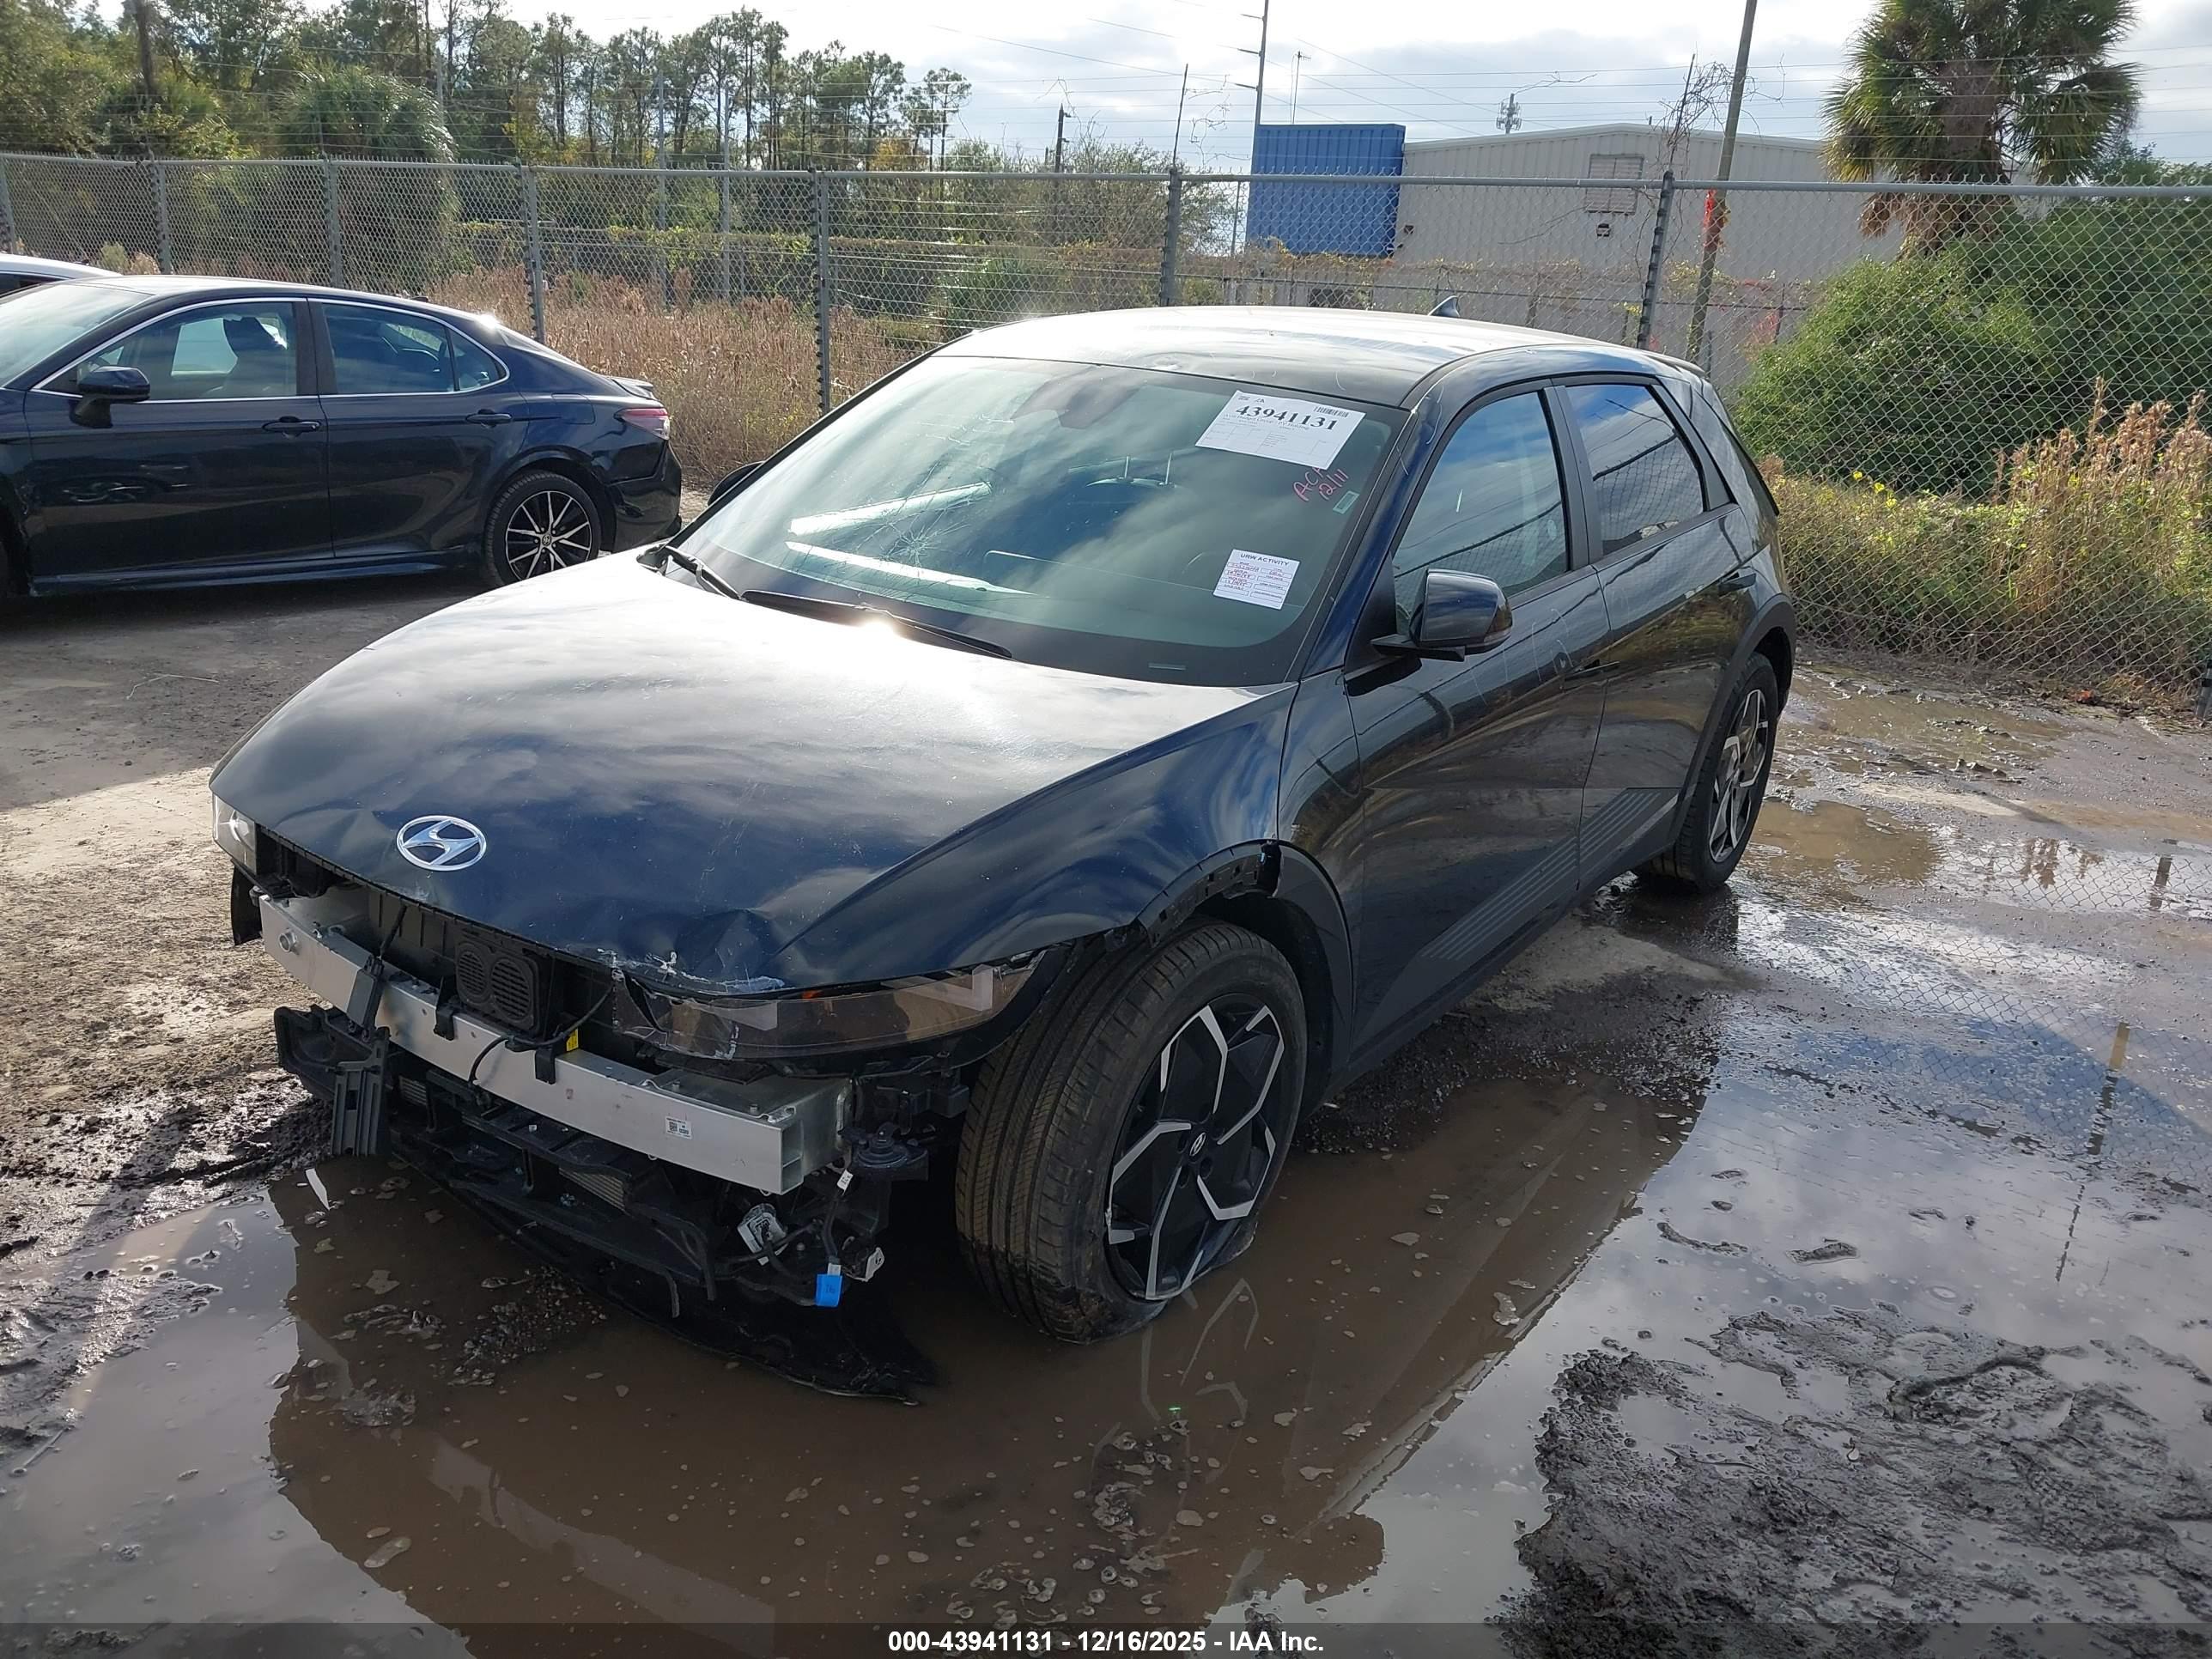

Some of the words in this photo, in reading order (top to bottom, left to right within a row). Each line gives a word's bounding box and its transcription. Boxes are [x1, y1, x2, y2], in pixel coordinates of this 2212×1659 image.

[1235, 405, 1338, 430] 43941131
[1319, 469, 1349, 500] 12/11
[1257, 556, 1290, 566] ACTIVITY
